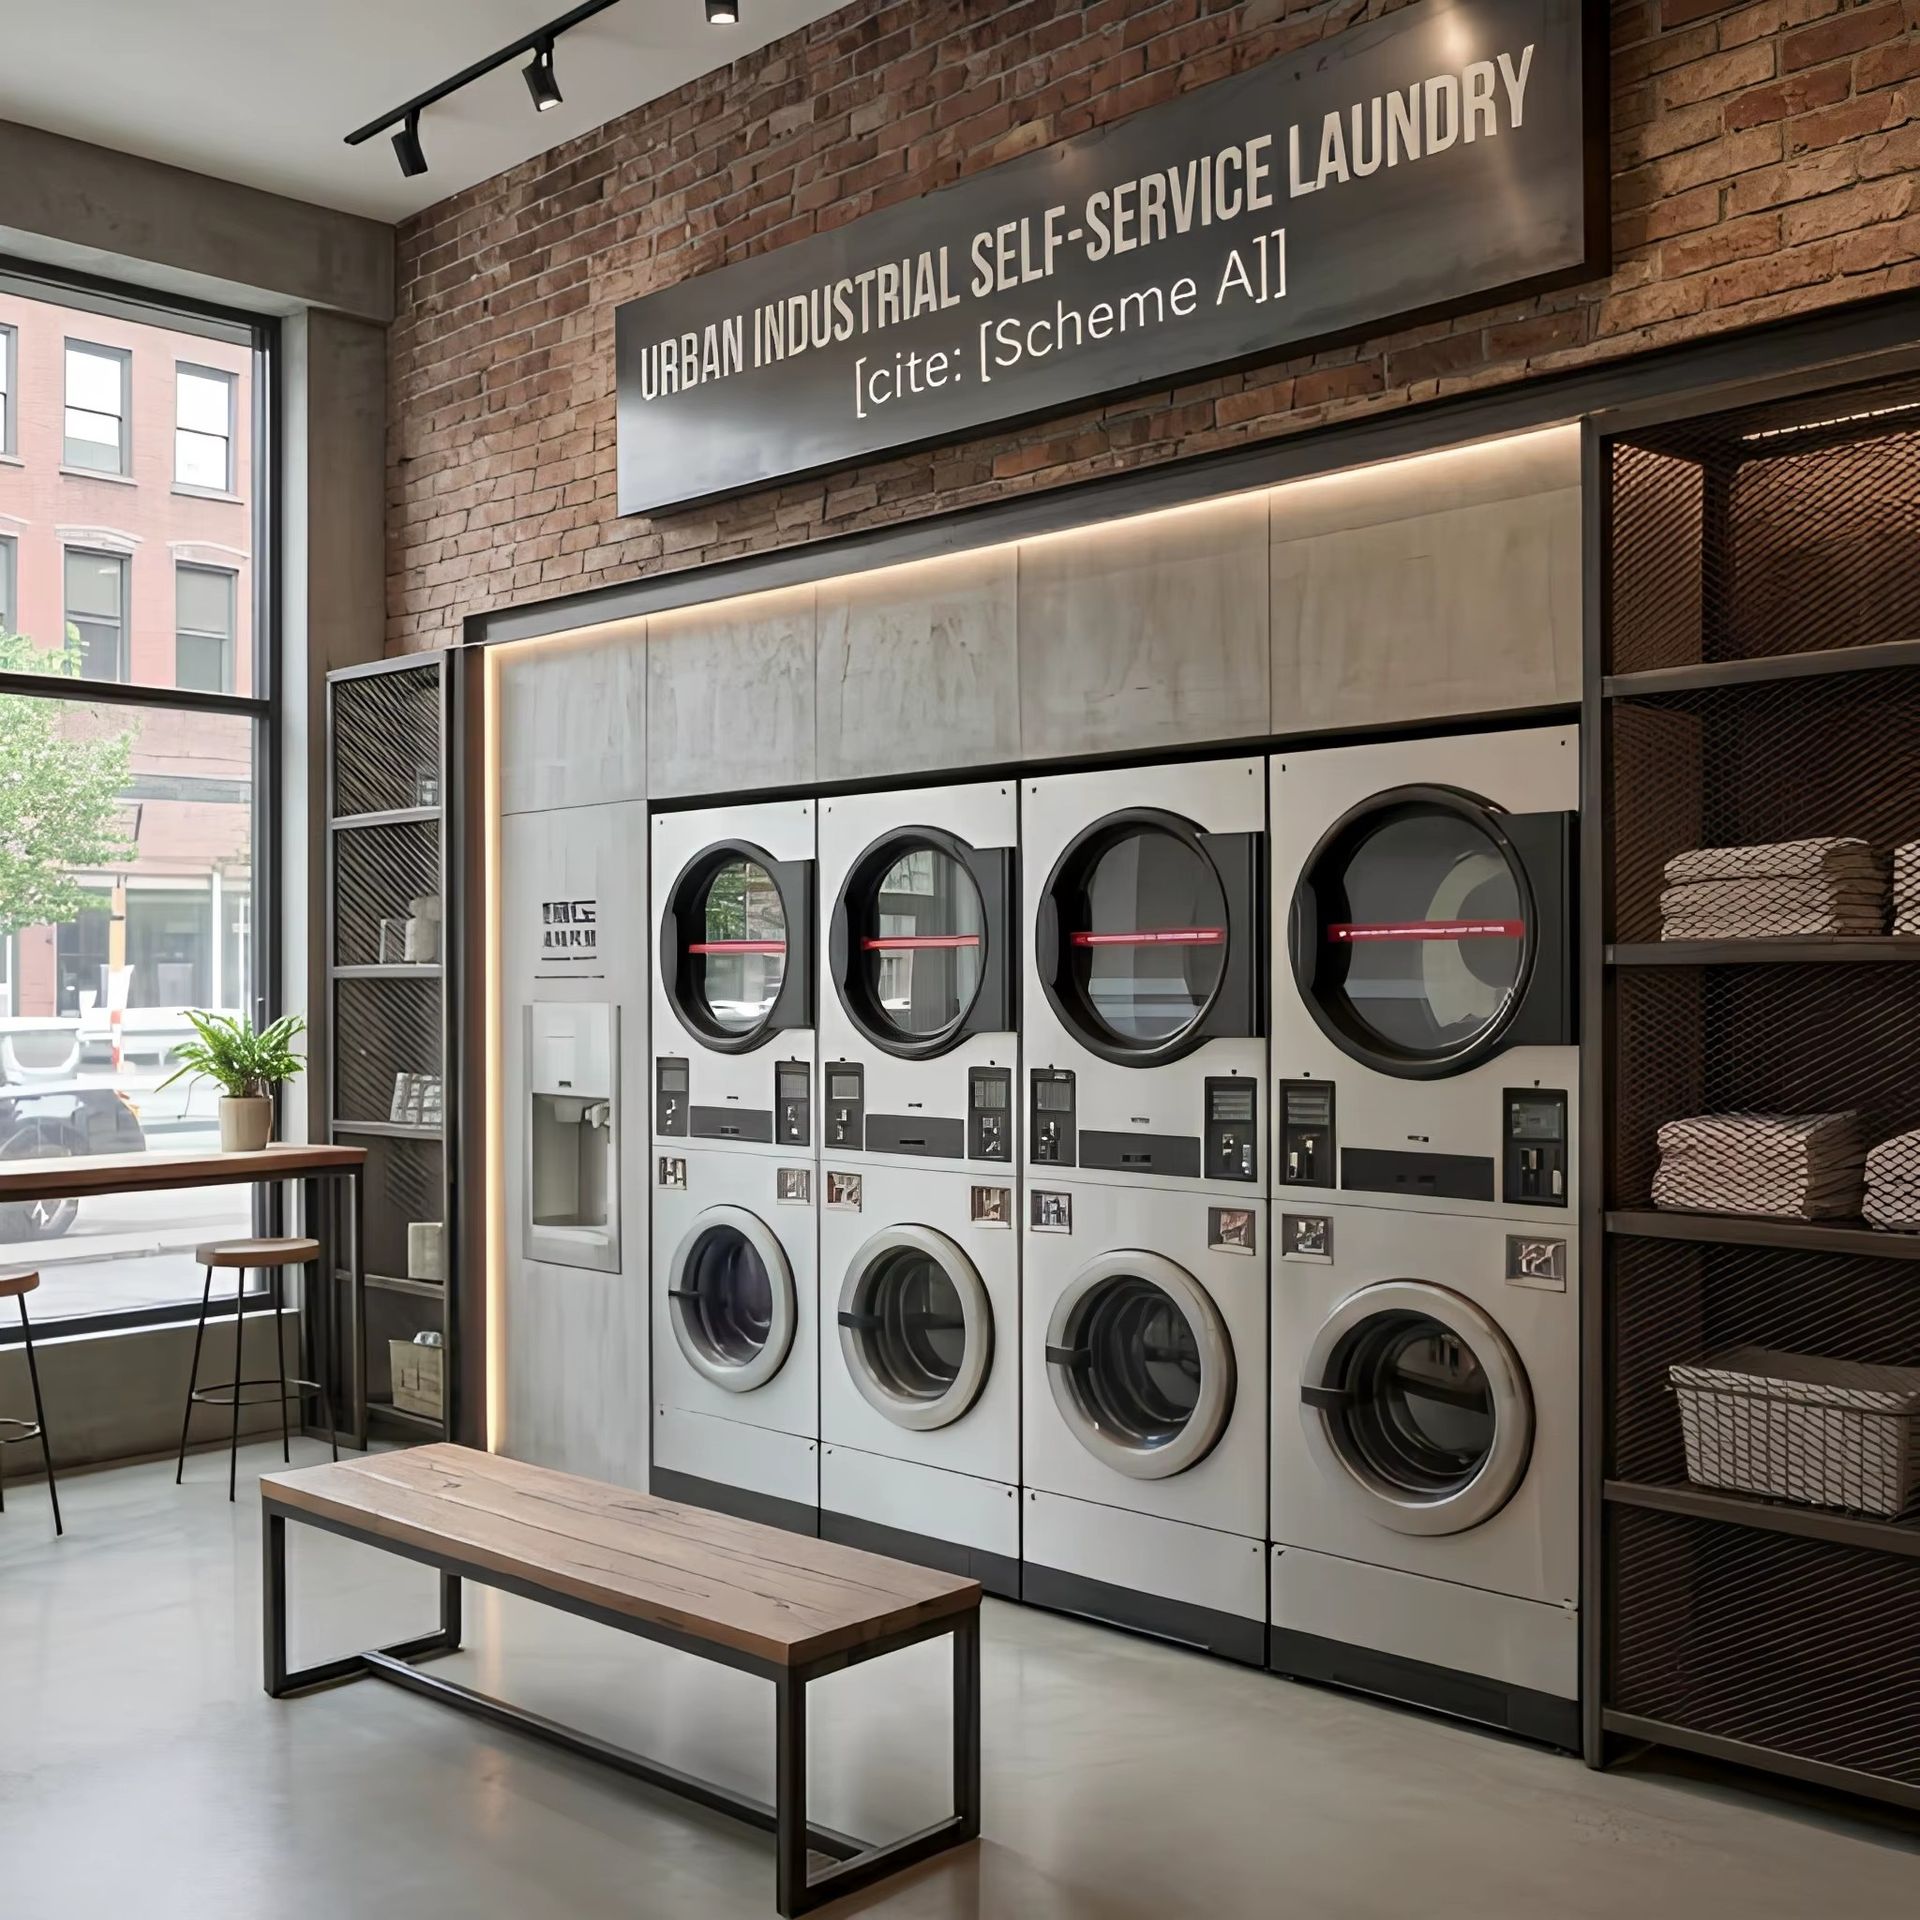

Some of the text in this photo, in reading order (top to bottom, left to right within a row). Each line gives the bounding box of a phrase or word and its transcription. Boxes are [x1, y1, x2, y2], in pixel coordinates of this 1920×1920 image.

[641, 44, 1535, 401] URBAN INDUSTRIAL SELF-SERVICE LAUNDRY
[855, 228, 1287, 418] [cite: [Scheme A]]
